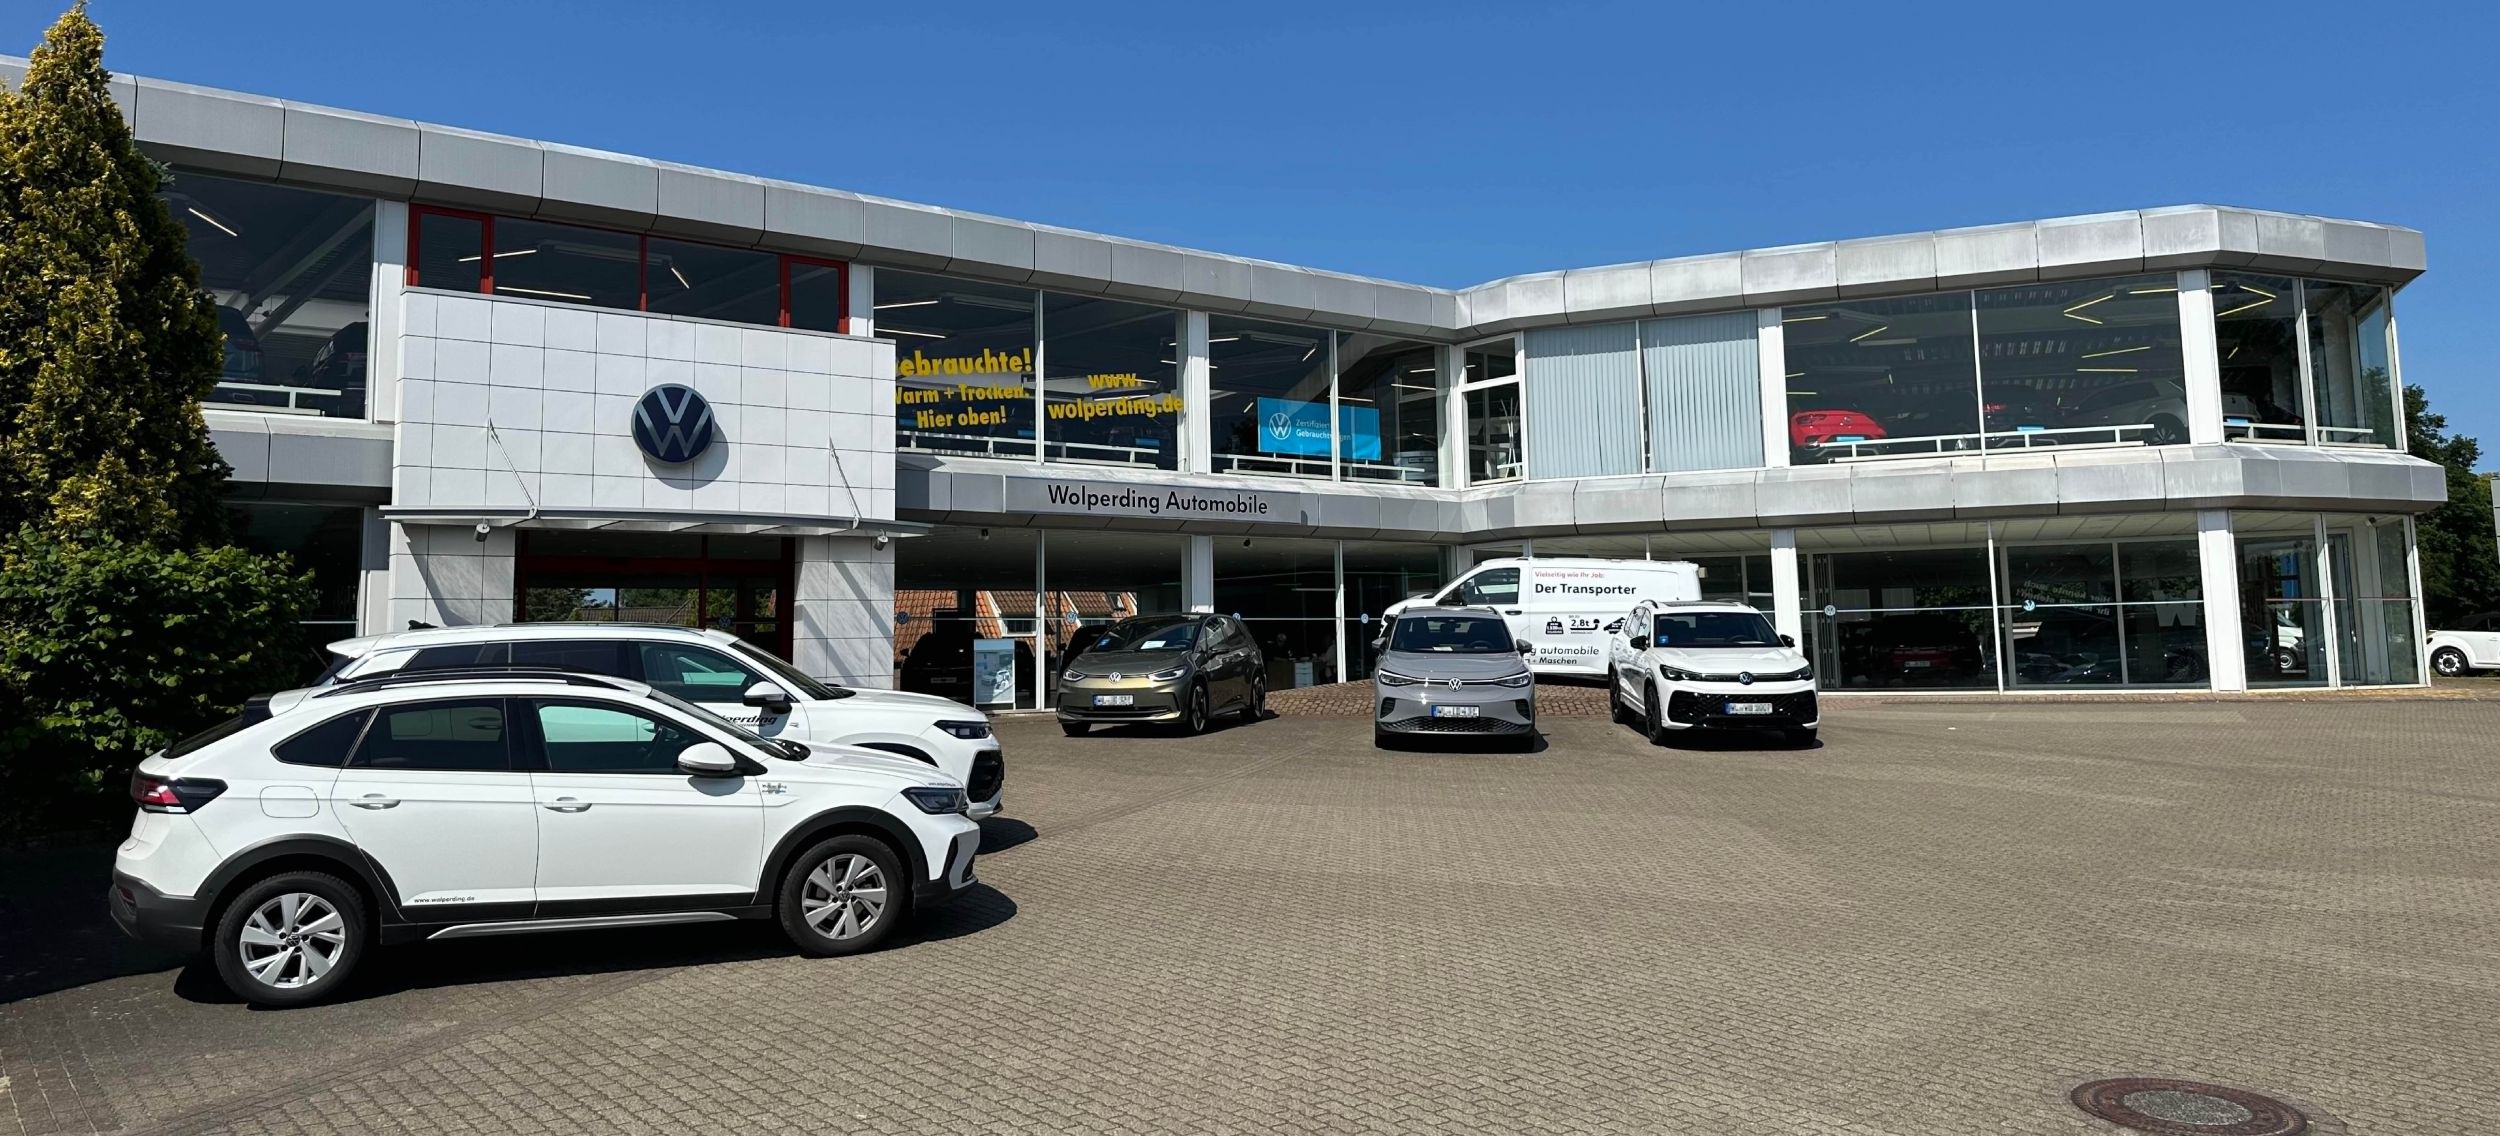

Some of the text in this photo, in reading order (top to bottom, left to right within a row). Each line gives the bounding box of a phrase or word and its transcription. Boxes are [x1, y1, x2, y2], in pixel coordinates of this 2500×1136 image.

[896, 347, 1033, 377] ebrauchte!
[958, 383, 1030, 401] Trocken.
[917, 405, 1007, 429] Hier oben!
[1047, 394, 1184, 422] wolperding.de
[1047, 484, 1268, 514] Wolperding Automobile
[1535, 583, 1637, 597] Der Transporter
[1539, 657, 1577, 665] Maschen
[1540, 646, 1600, 655] automobile
